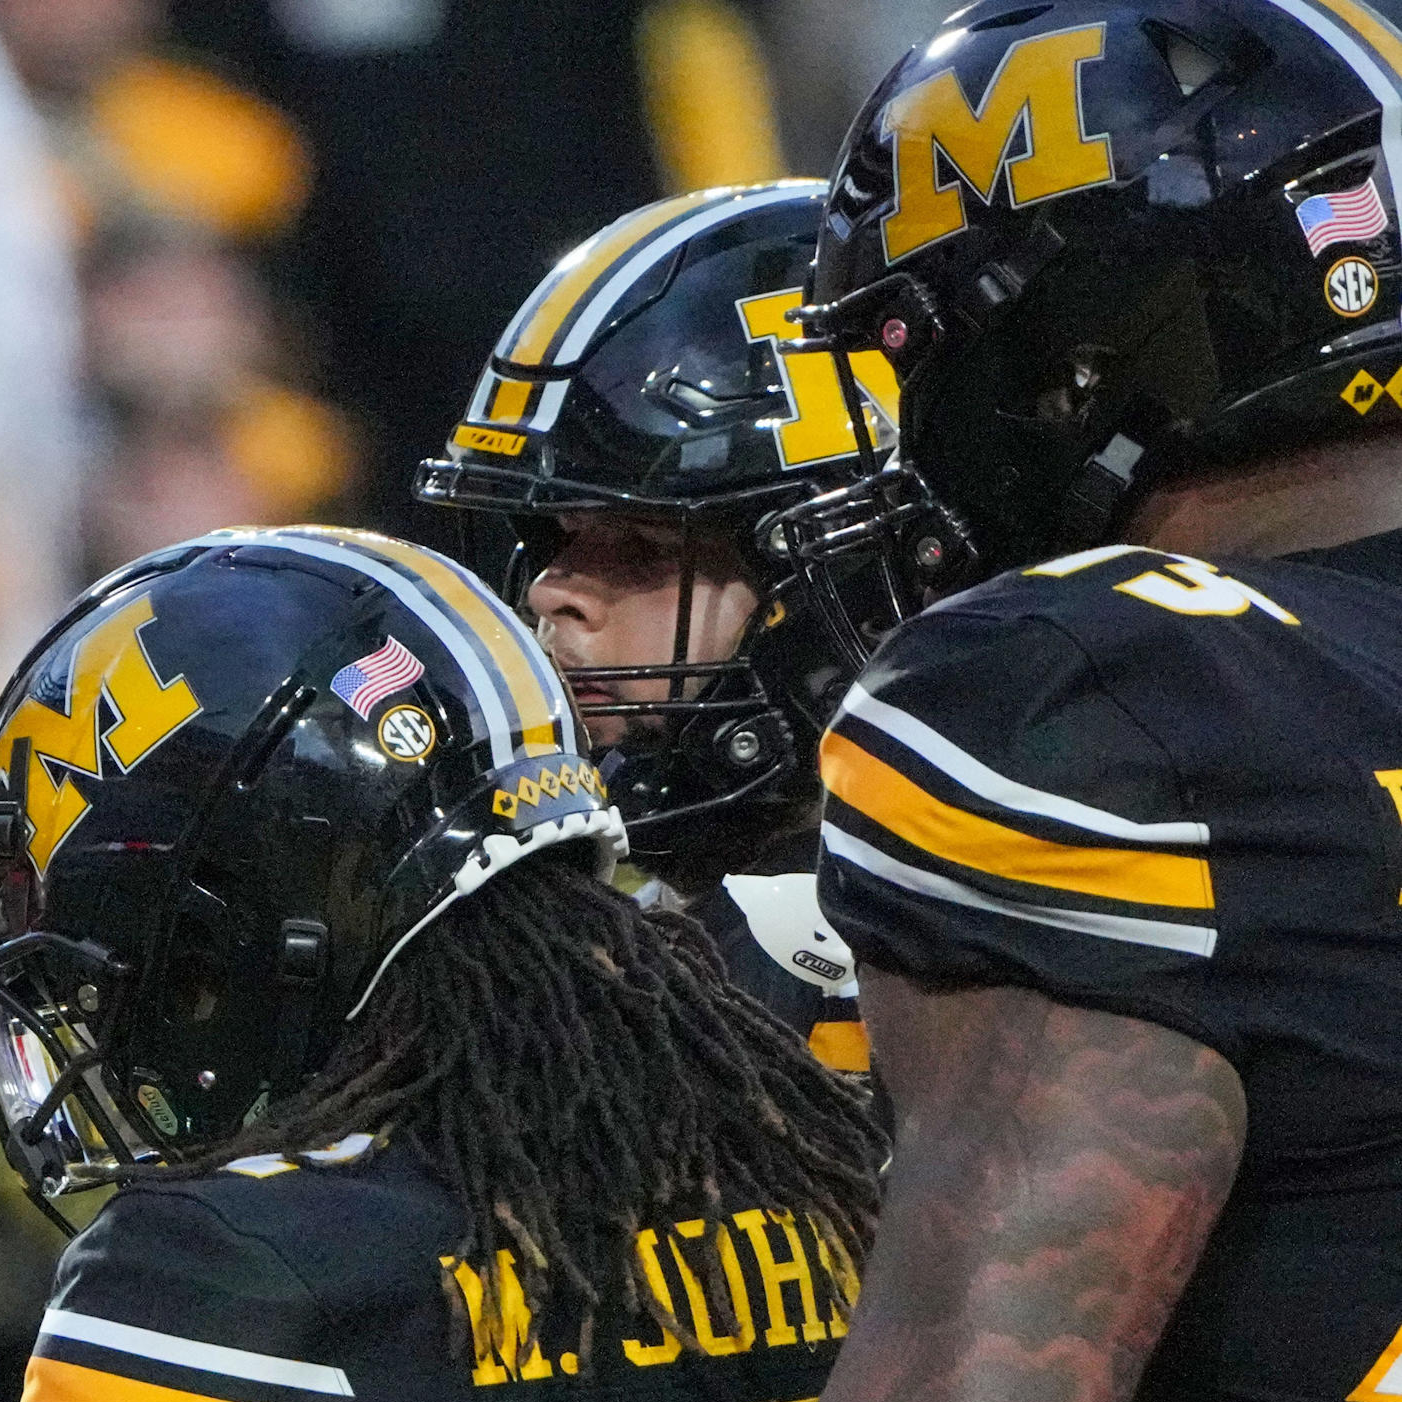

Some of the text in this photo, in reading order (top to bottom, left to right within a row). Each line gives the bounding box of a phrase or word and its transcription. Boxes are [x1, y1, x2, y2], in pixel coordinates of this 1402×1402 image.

[879, 21, 1116, 266] M
[1328, 262, 1377, 308] SEC
[380, 708, 434, 758] SEC
